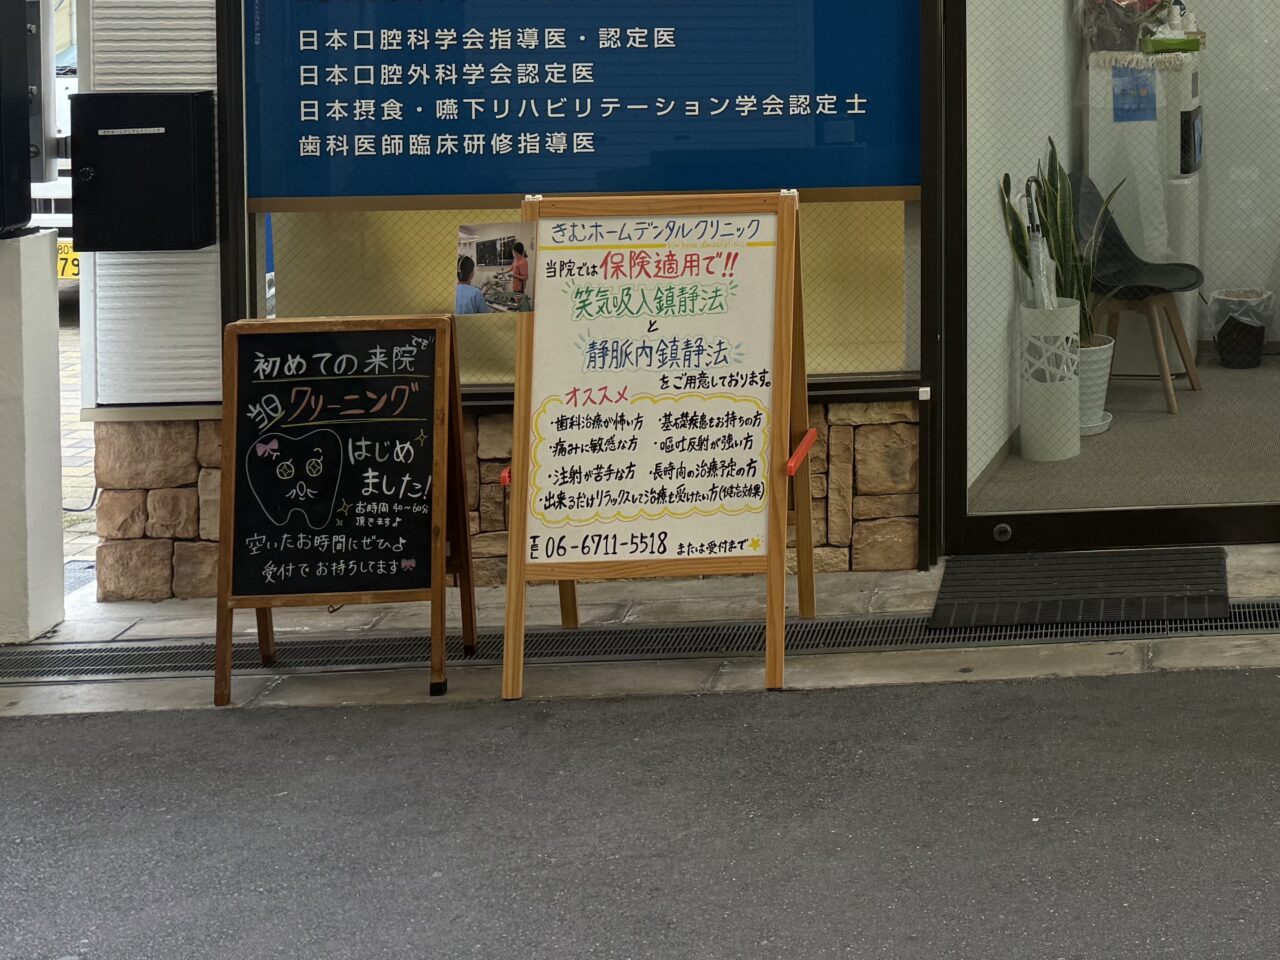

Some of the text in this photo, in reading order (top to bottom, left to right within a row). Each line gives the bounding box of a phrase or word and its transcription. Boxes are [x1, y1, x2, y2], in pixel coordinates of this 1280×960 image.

[299, 27, 677, 52] 日本口腔科学会指導医・認定医
[299, 62, 595, 86] 日本口腔外科学会認定医
[300, 93, 868, 122] 日本摂食・嚥下リハビリテーション学会認定士
[299, 131, 595, 156] 歯科医師臨床研修指導医
[551, 219, 761, 244] きむホームデンタルクリニック
[574, 285, 725, 318] 笑気吸入鎮静法
[647, 319, 659, 333] と
[253, 344, 418, 380] 初めての来院
[586, 337, 729, 370] 静脈内鎮静法
[660, 370, 772, 390] をご用意しております。
[246, 382, 419, 429] 当日 クリーニング
[565, 386, 629, 407] オススメ
[348, 436, 414, 465] はじめ
[545, 531, 668, 558] 06-6711-5518
[676, 539, 748, 556] または受付まで
